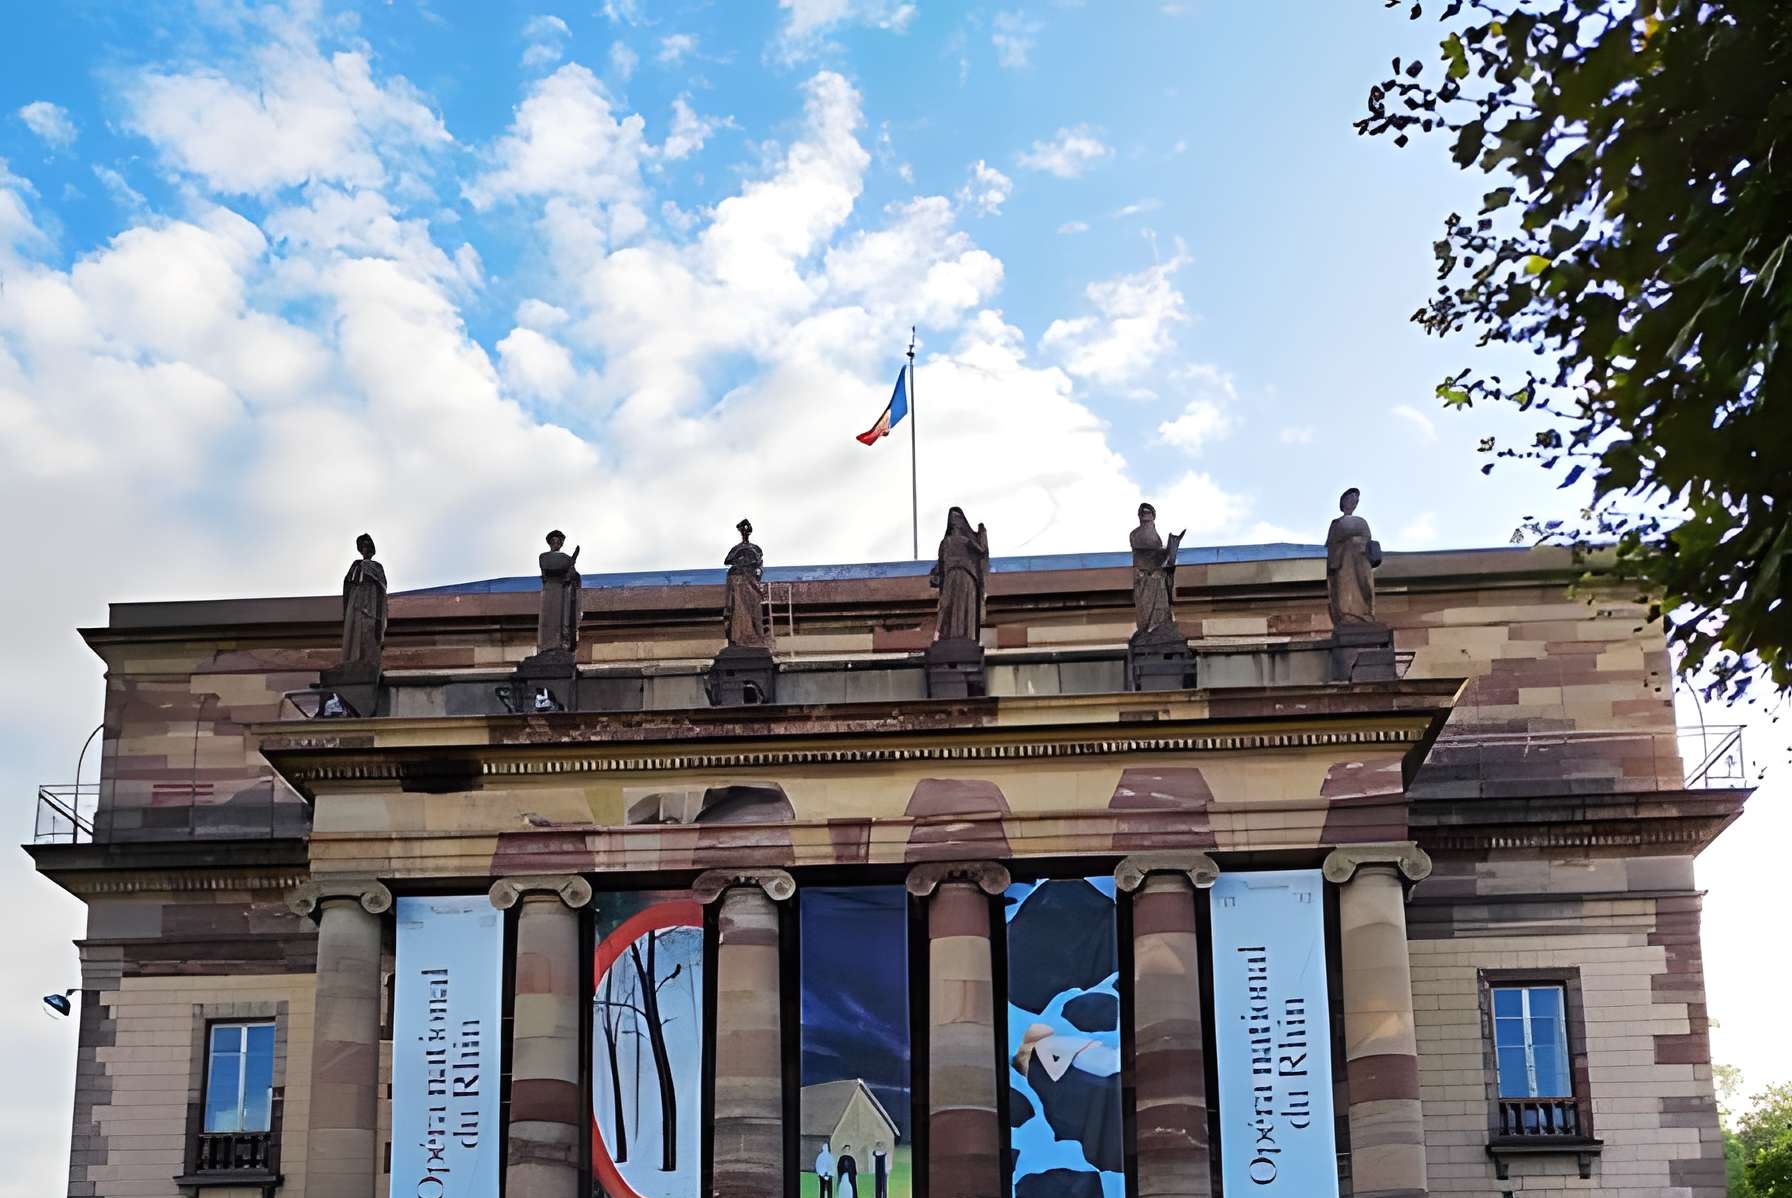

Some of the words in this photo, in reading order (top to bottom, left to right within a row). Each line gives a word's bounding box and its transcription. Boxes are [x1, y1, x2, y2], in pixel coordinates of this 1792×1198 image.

[418, 967, 450, 1095] national
[1237, 945, 1272, 1074] national
[1277, 997, 1308, 1075] Rhin
[452, 1018, 481, 1096] Rhin
[451, 1110, 480, 1148] du
[1246, 1084, 1281, 1184] Opéra
[1281, 1090, 1311, 1128] du
